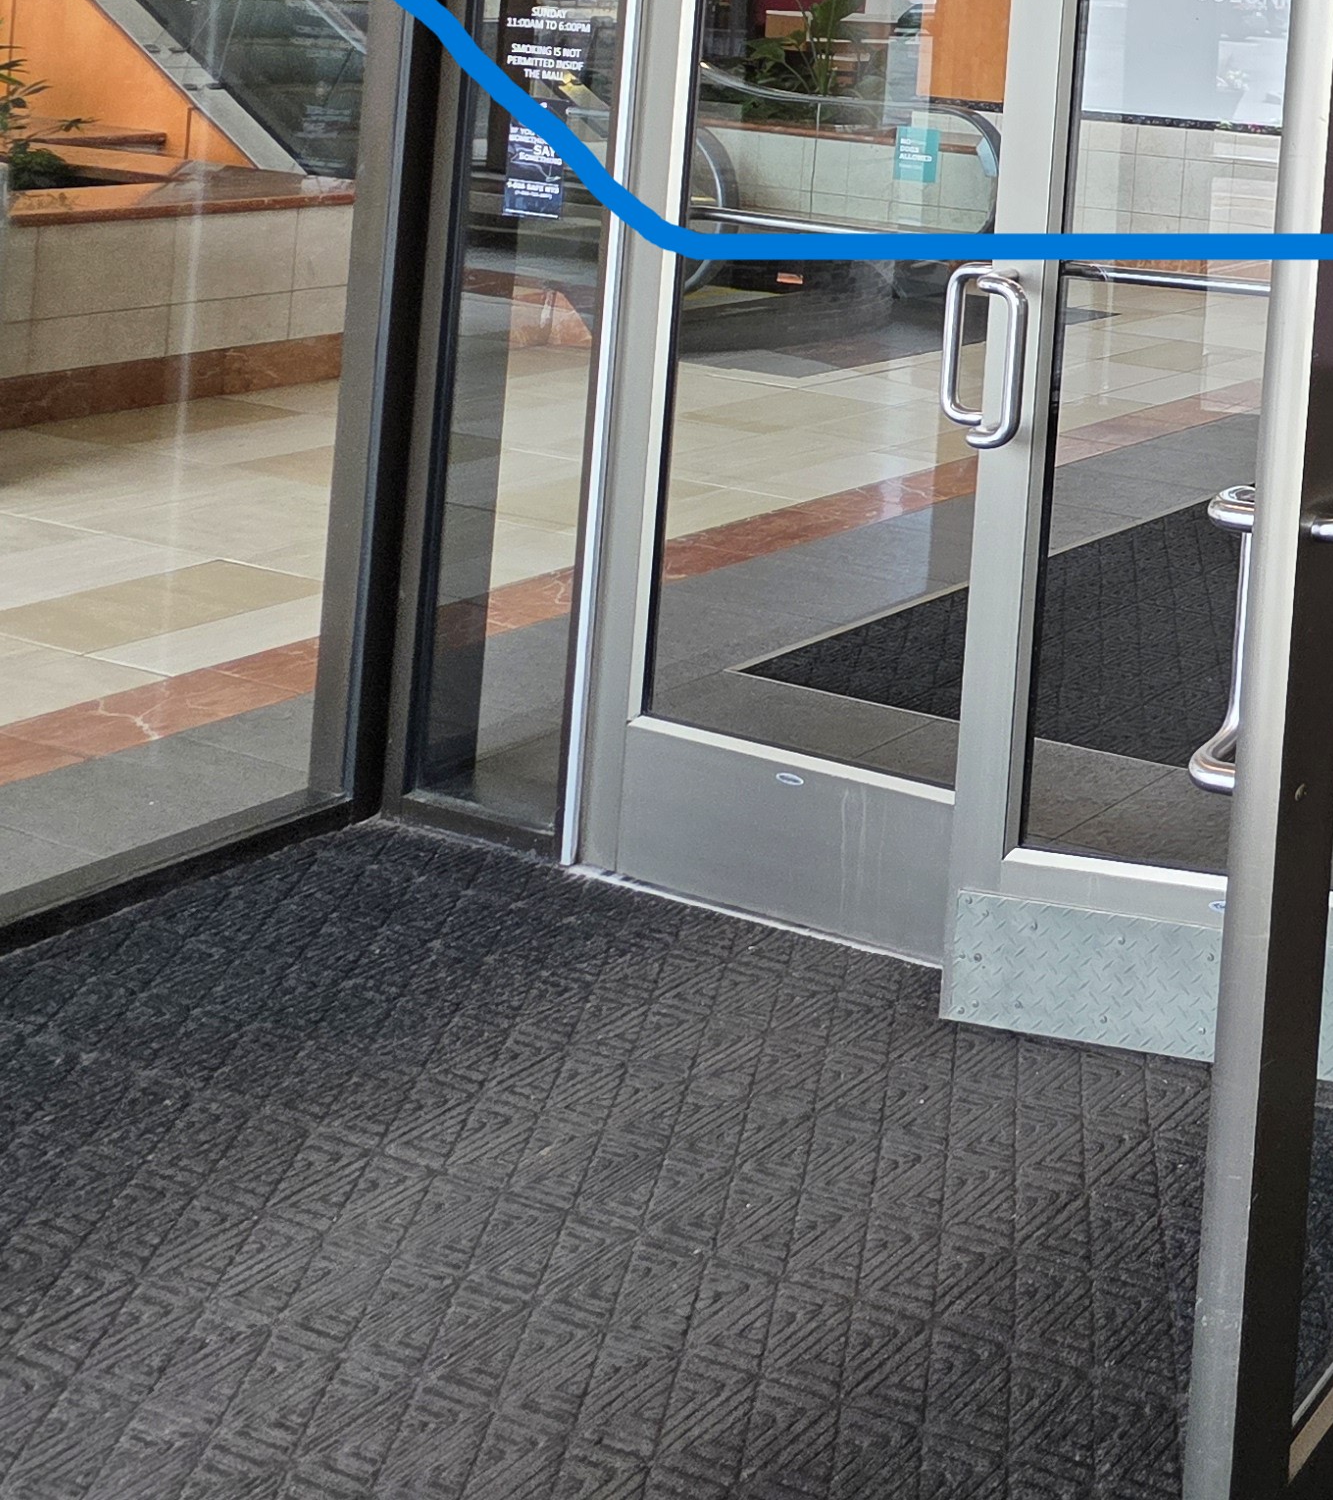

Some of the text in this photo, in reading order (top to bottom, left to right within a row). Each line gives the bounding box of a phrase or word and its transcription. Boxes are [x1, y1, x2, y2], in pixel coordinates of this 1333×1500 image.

[531, 6, 567, 18] SUNDAY
[545, 20, 557, 30] TO
[523, 69, 540, 79] THE
